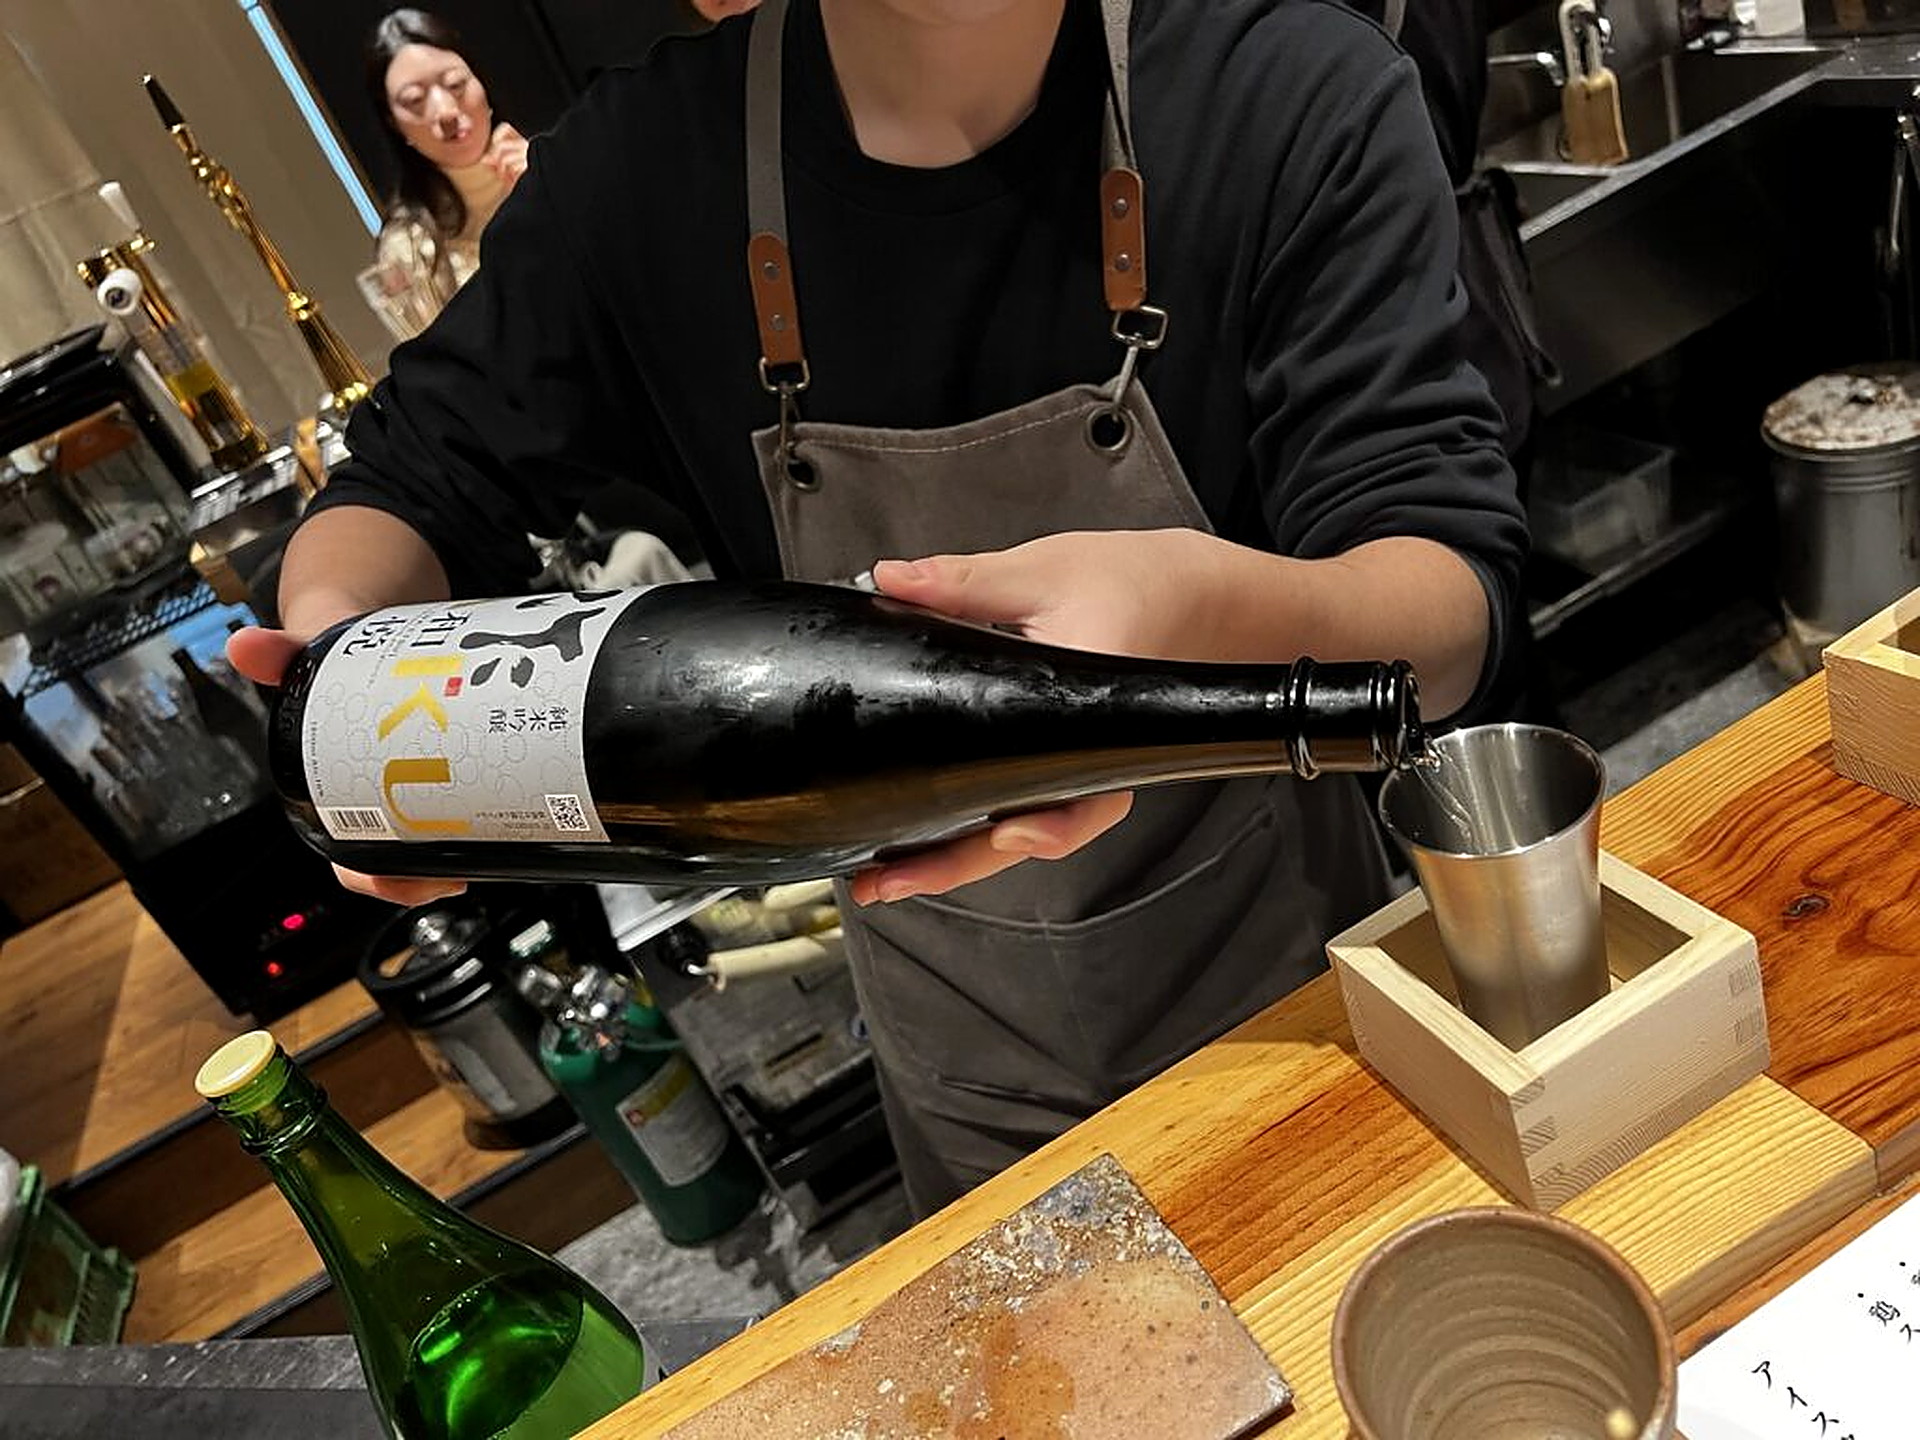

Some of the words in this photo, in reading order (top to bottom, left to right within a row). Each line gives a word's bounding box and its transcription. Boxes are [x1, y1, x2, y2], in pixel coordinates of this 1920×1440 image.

[488, 705, 569, 734] 純米吟醸
[1751, 1361, 1856, 1440] アイス
